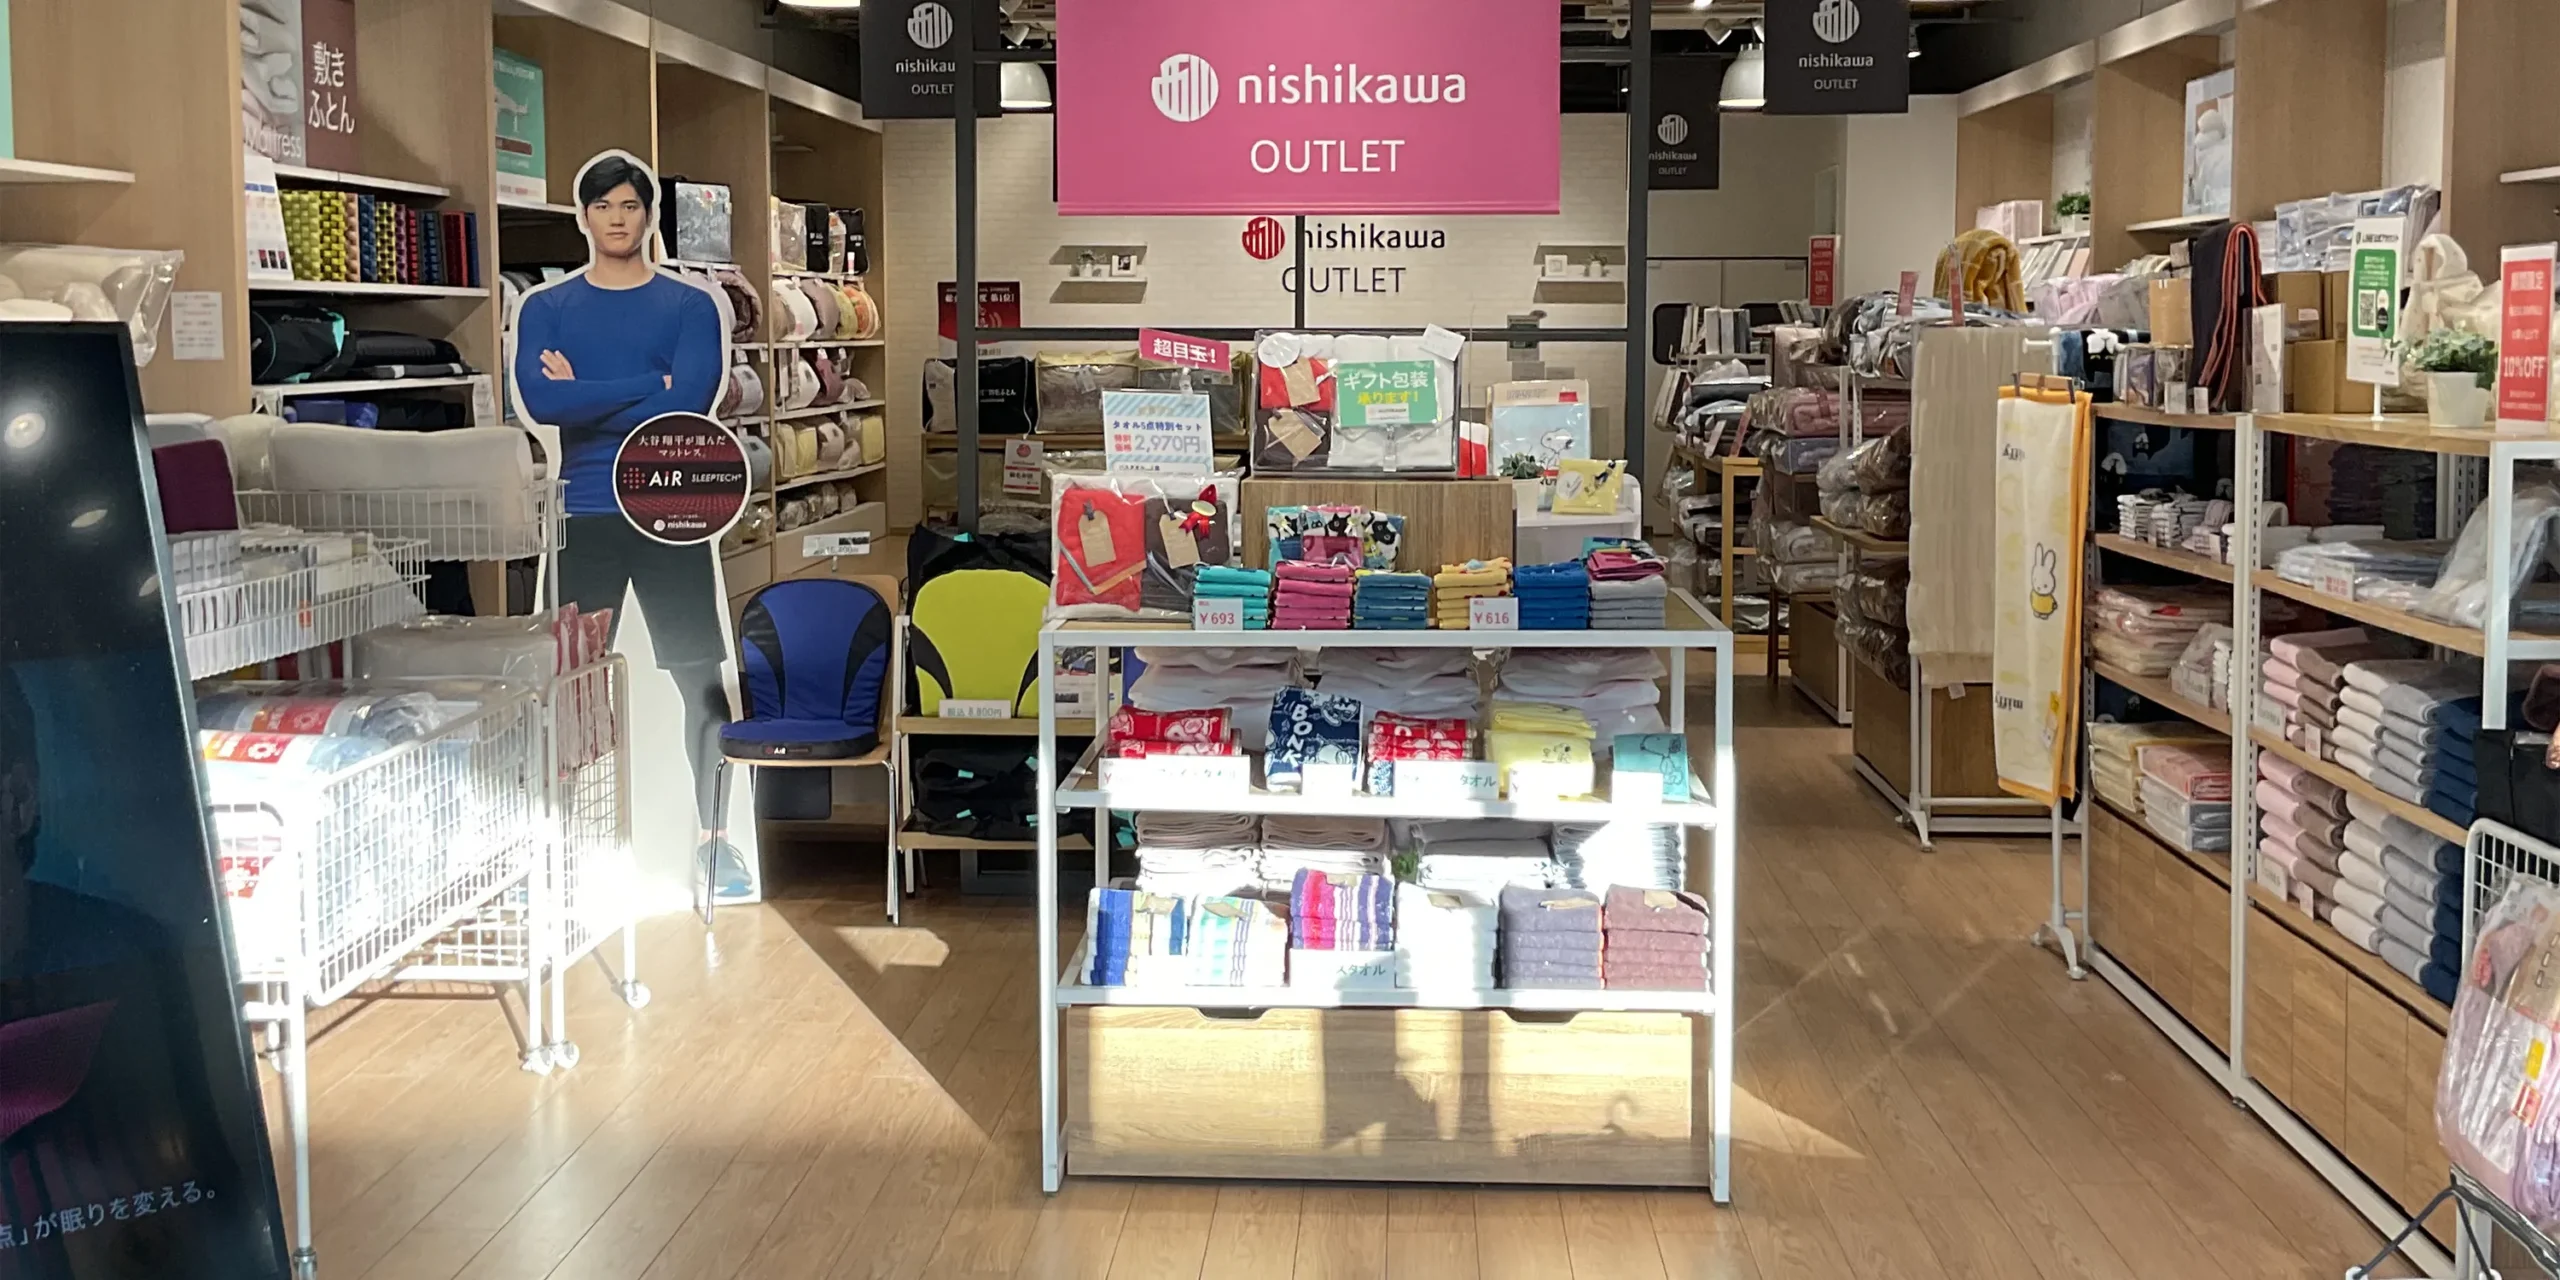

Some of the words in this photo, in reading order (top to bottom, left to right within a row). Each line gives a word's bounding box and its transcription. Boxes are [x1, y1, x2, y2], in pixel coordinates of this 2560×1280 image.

[312, 41, 346, 88] 敷き
[1798, 53, 1874, 68] nishikawa
[911, 83, 955, 95] OUTLET
[1237, 64, 1466, 105] nishikawa
[1813, 78, 1858, 90] OUTLET
[308, 90, 356, 134] ふとん
[1249, 139, 1406, 175] OUTLET
[1153, 337, 1217, 364] 超目玉!
[1343, 369, 1429, 391] ギフト包装
[1134, 434, 1201, 454] 2,970円
[667, 520, 707, 529] nishikawa
[1200, 611, 1236, 625] ¥693
[1474, 611, 1510, 625] ¥616
